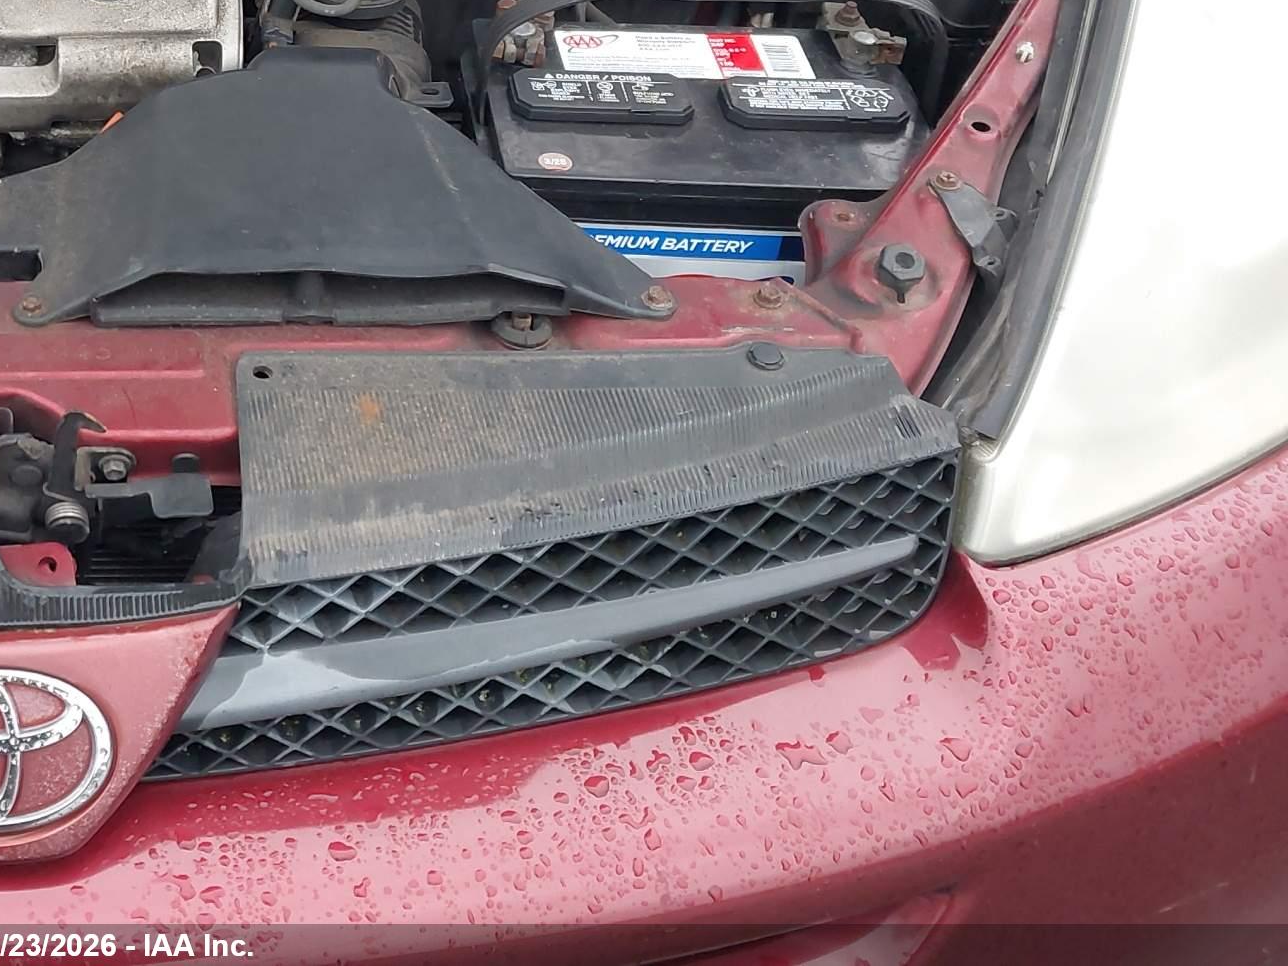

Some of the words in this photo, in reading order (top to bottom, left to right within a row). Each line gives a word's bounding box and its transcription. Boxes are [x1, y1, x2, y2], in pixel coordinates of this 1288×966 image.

[564, 36, 600, 47] AAA
[556, 73, 600, 81] DANGER
[660, 237, 754, 253] BATTERY
